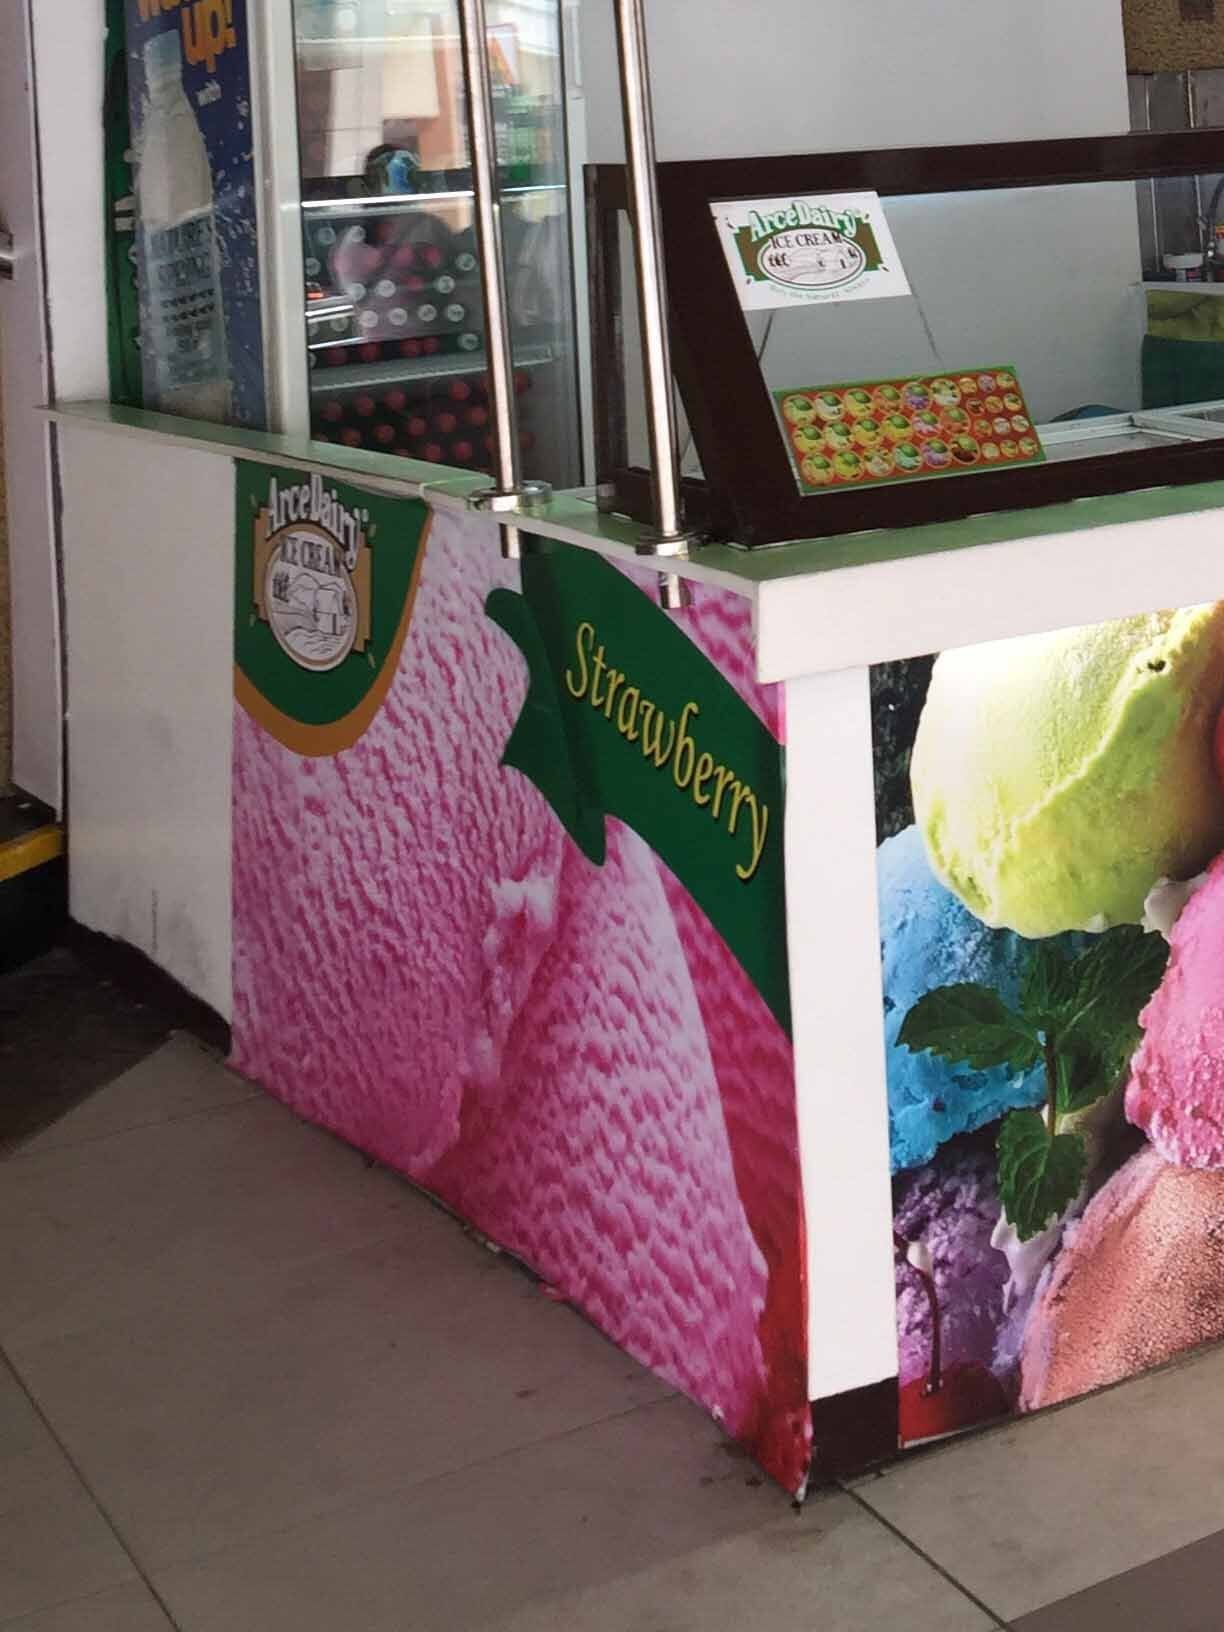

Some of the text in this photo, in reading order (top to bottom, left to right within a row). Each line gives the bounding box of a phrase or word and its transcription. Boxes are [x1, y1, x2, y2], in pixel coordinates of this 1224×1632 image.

[750, 200, 857, 242] Arce Dairy
[771, 232, 844, 249] ICE CREAM
[265, 474, 361, 571] Arce Dairy
[566, 622, 768, 879] Strawberry
